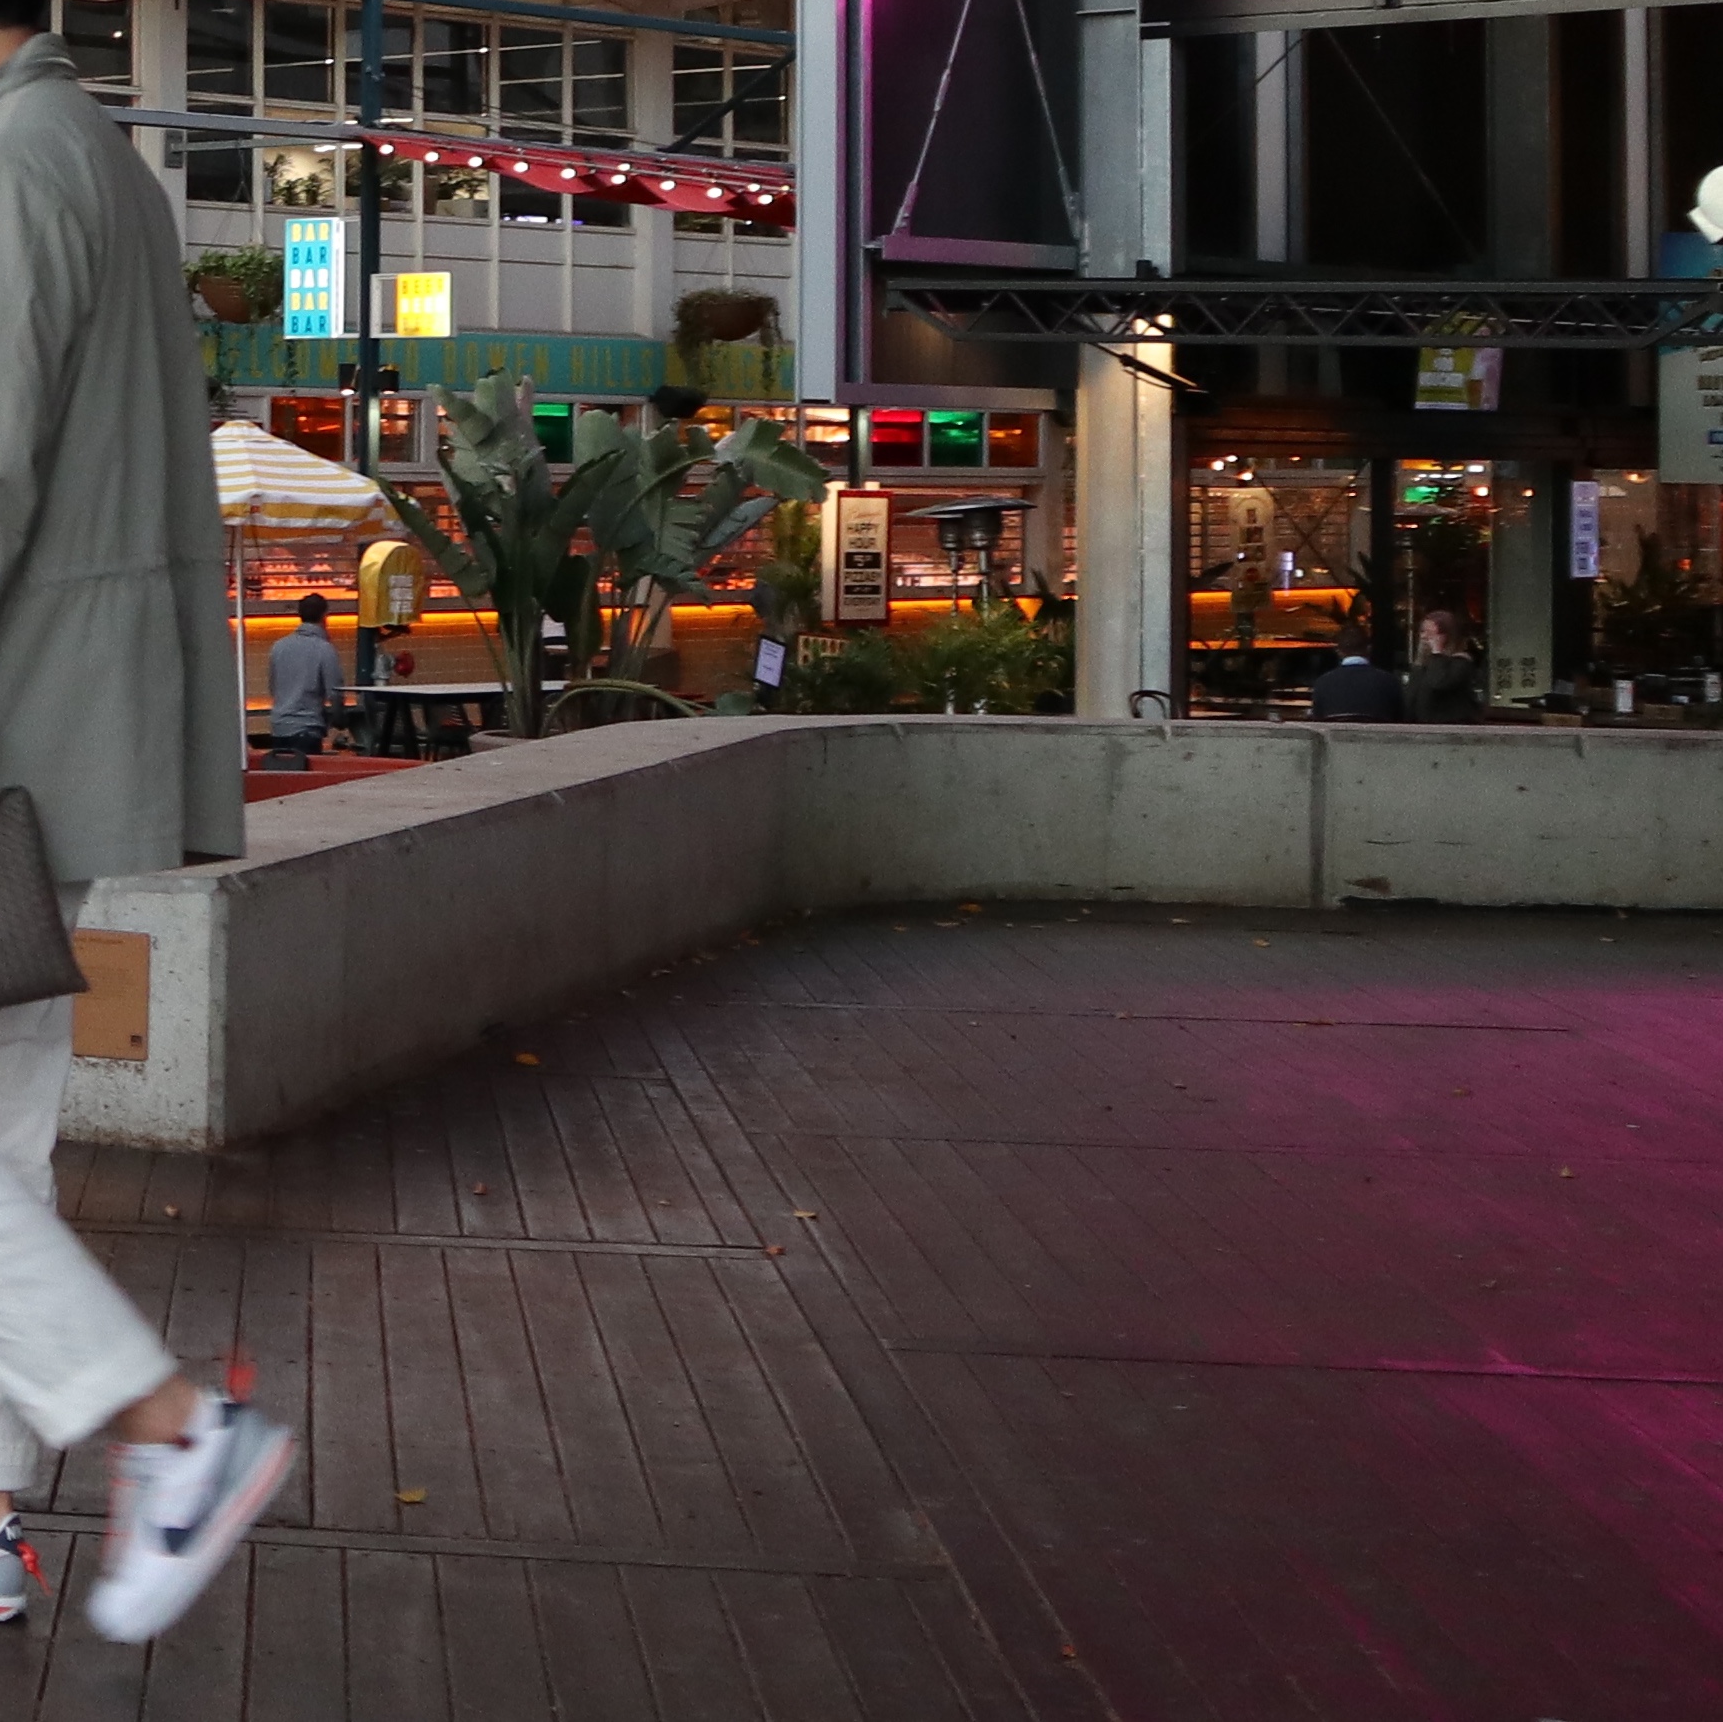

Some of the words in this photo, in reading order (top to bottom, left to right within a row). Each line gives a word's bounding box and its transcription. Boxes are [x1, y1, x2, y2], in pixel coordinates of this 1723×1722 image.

[290, 223, 329, 243] BAR
[291, 246, 327, 265] BAR
[290, 268, 329, 289] BAR
[290, 291, 329, 311] BAR
[291, 315, 327, 334] BAR
